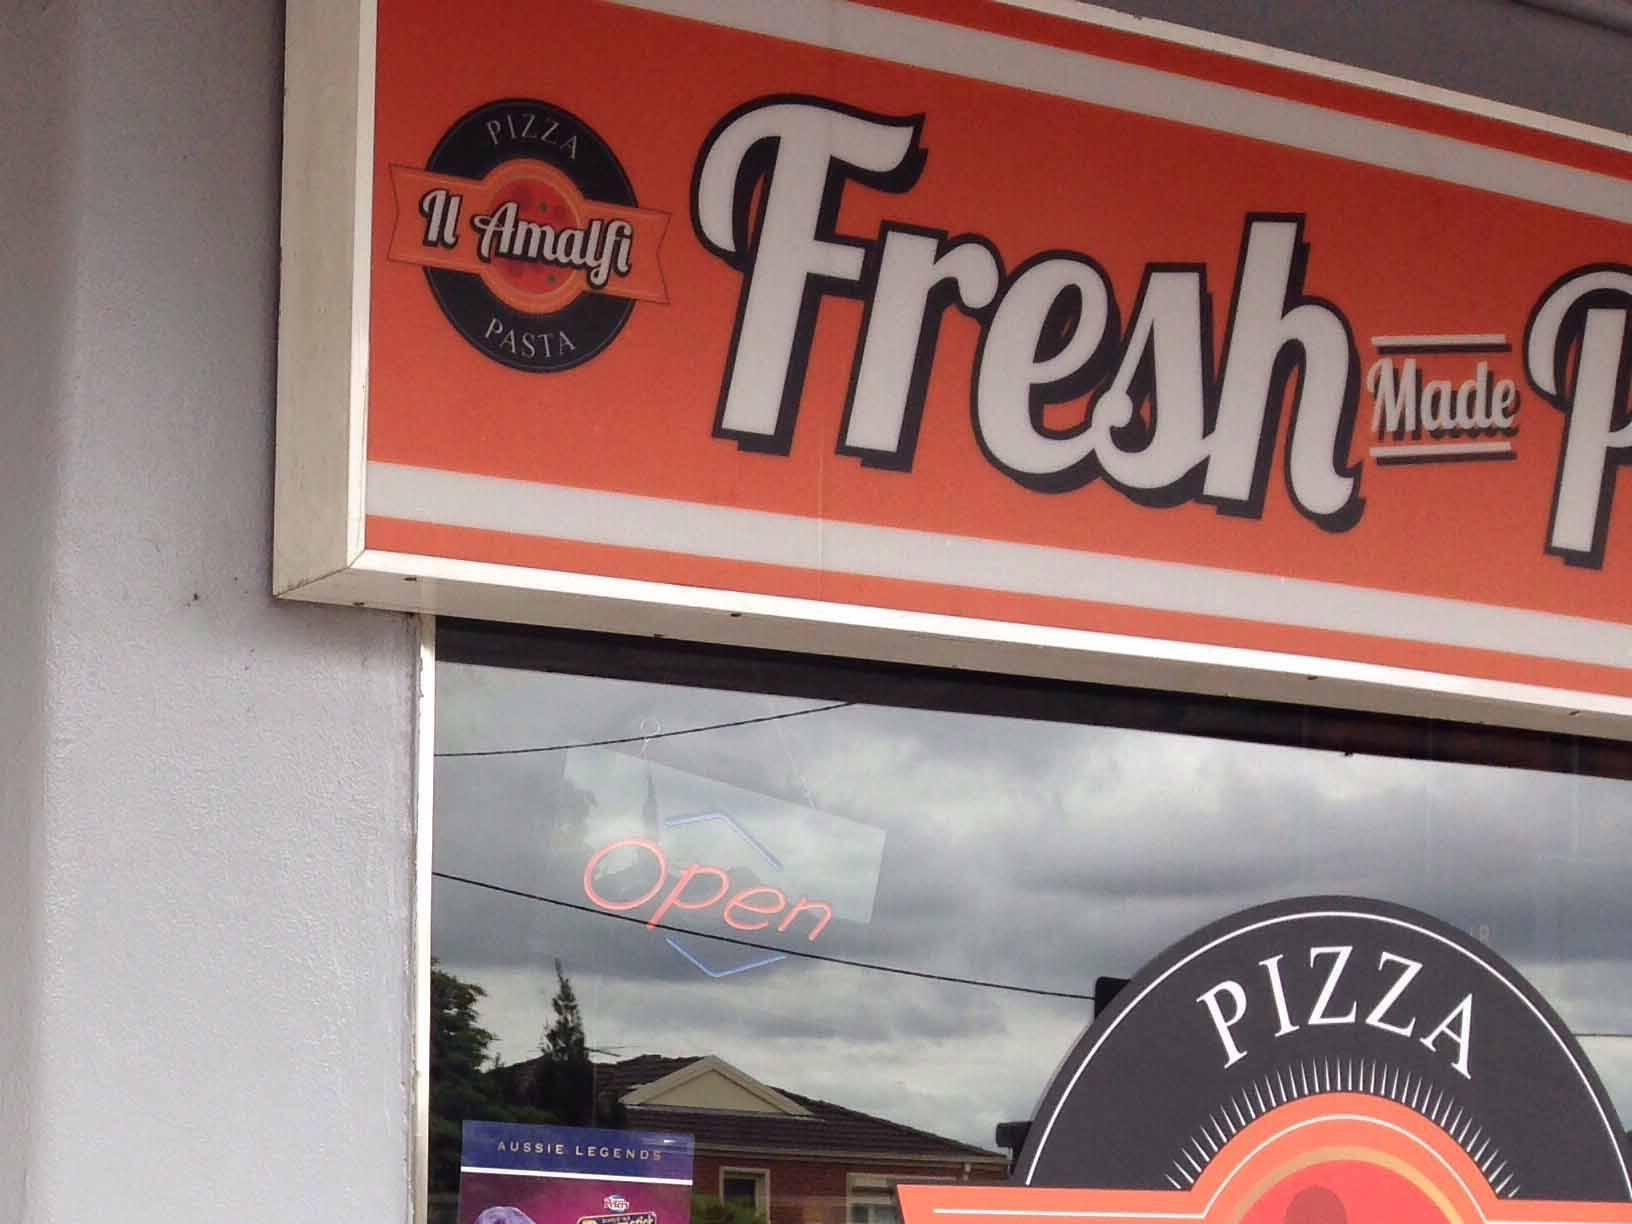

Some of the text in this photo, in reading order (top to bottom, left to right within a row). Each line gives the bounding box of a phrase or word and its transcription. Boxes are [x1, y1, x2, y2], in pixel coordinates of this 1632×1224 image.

[486, 112, 578, 161] PIZZA
[471, 201, 634, 287] Amalfi
[485, 318, 576, 359] PASTA
[691, 93, 1365, 532] Fresh
[1368, 357, 1520, 438] Made
[584, 838, 833, 943] Open
[1197, 945, 1475, 1080] PIZZA
[497, 1141, 662, 1161] AUSSIE LEGENDS
